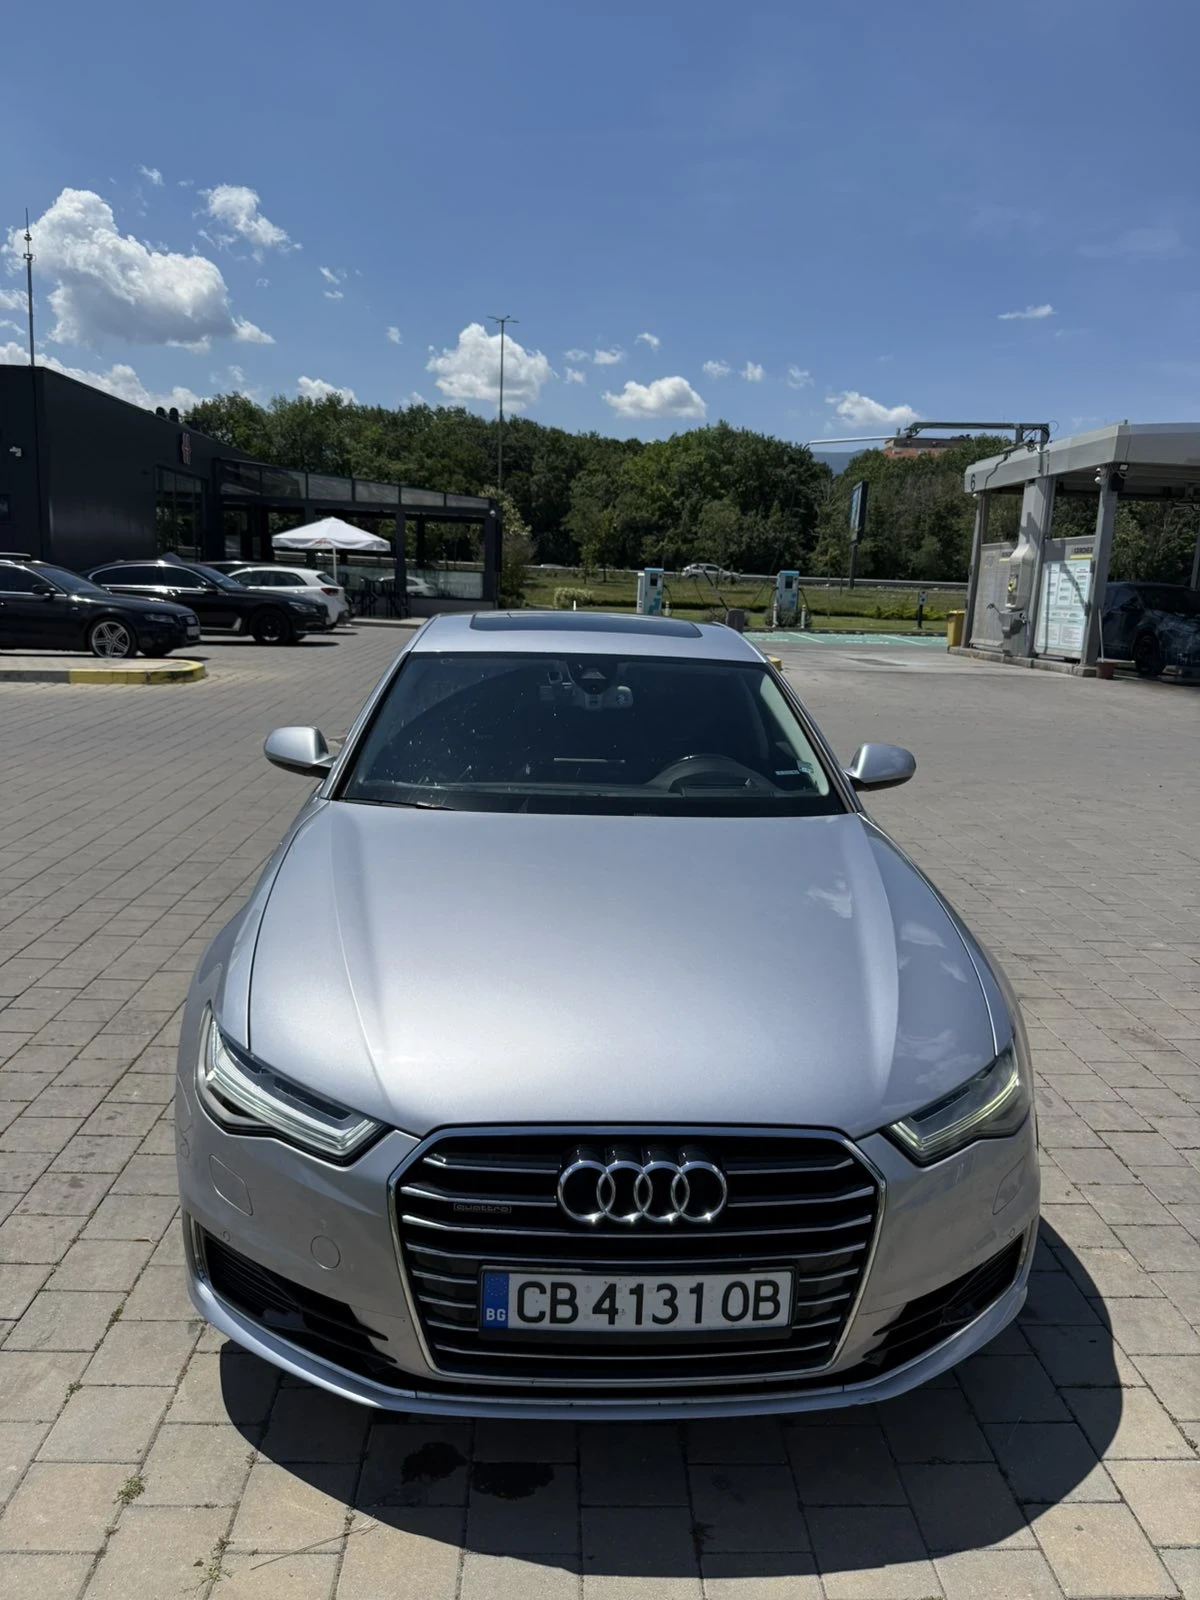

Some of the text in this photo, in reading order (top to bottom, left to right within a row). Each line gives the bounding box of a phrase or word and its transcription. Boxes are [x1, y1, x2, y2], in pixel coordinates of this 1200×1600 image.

[970, 473, 976, 491] 6
[516, 1281, 580, 1324] CB
[591, 1282, 704, 1326] 4131
[486, 1307, 506, 1321] BG
